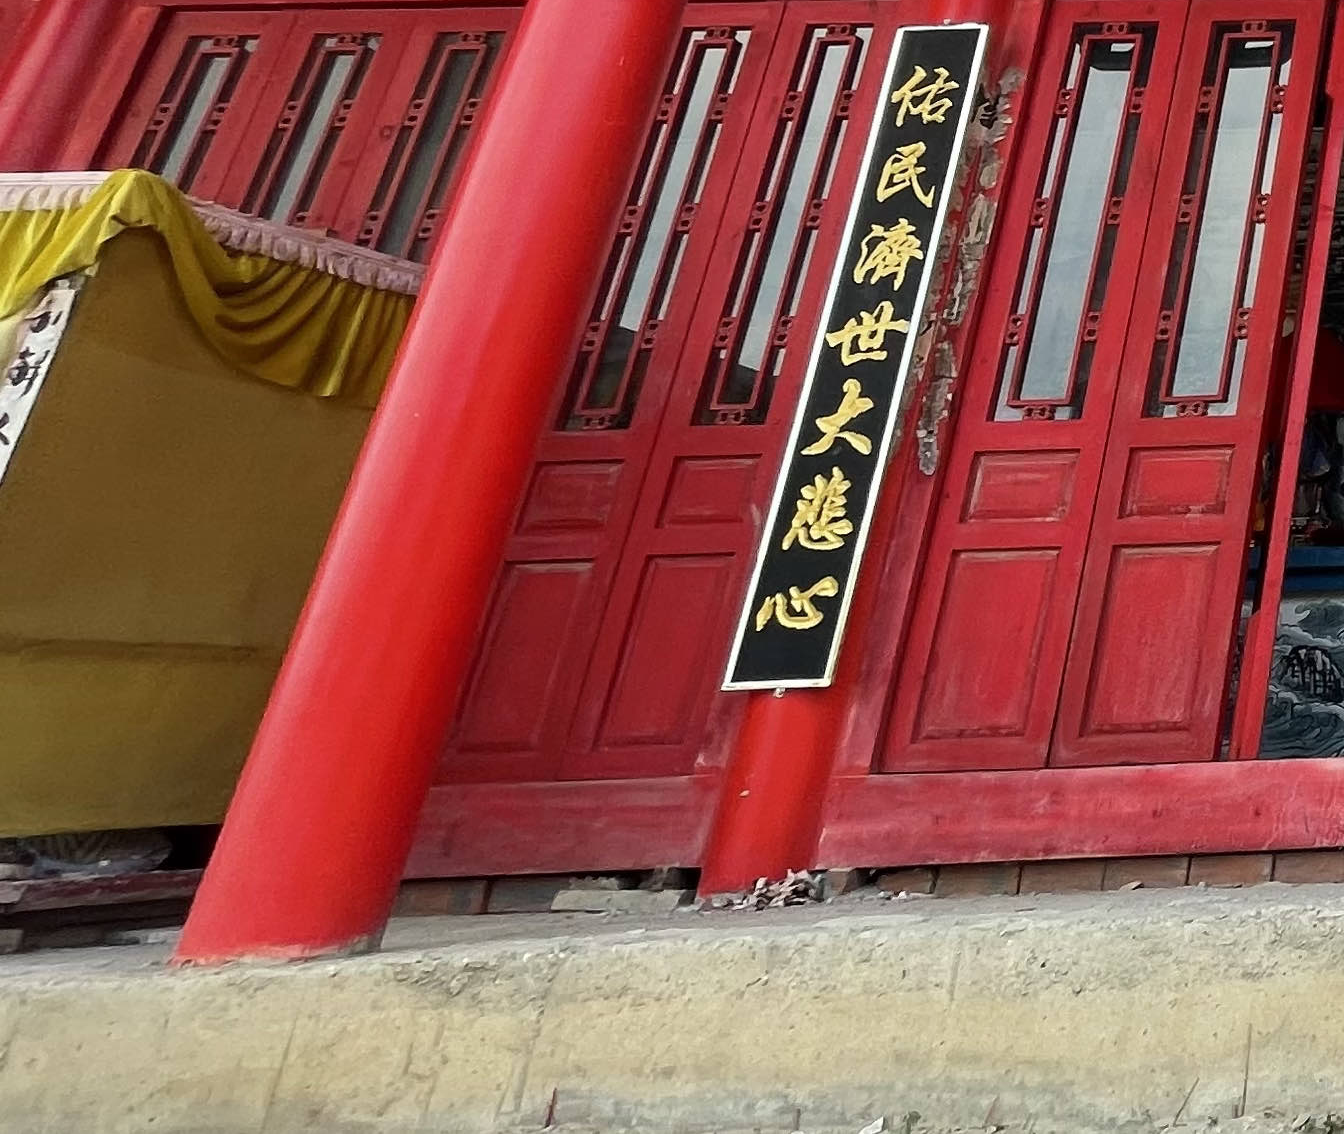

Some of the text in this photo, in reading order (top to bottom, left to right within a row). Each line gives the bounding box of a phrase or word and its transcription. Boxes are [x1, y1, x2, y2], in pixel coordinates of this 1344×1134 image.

[755, 65, 961, 631] 佑民濟世大悲心
